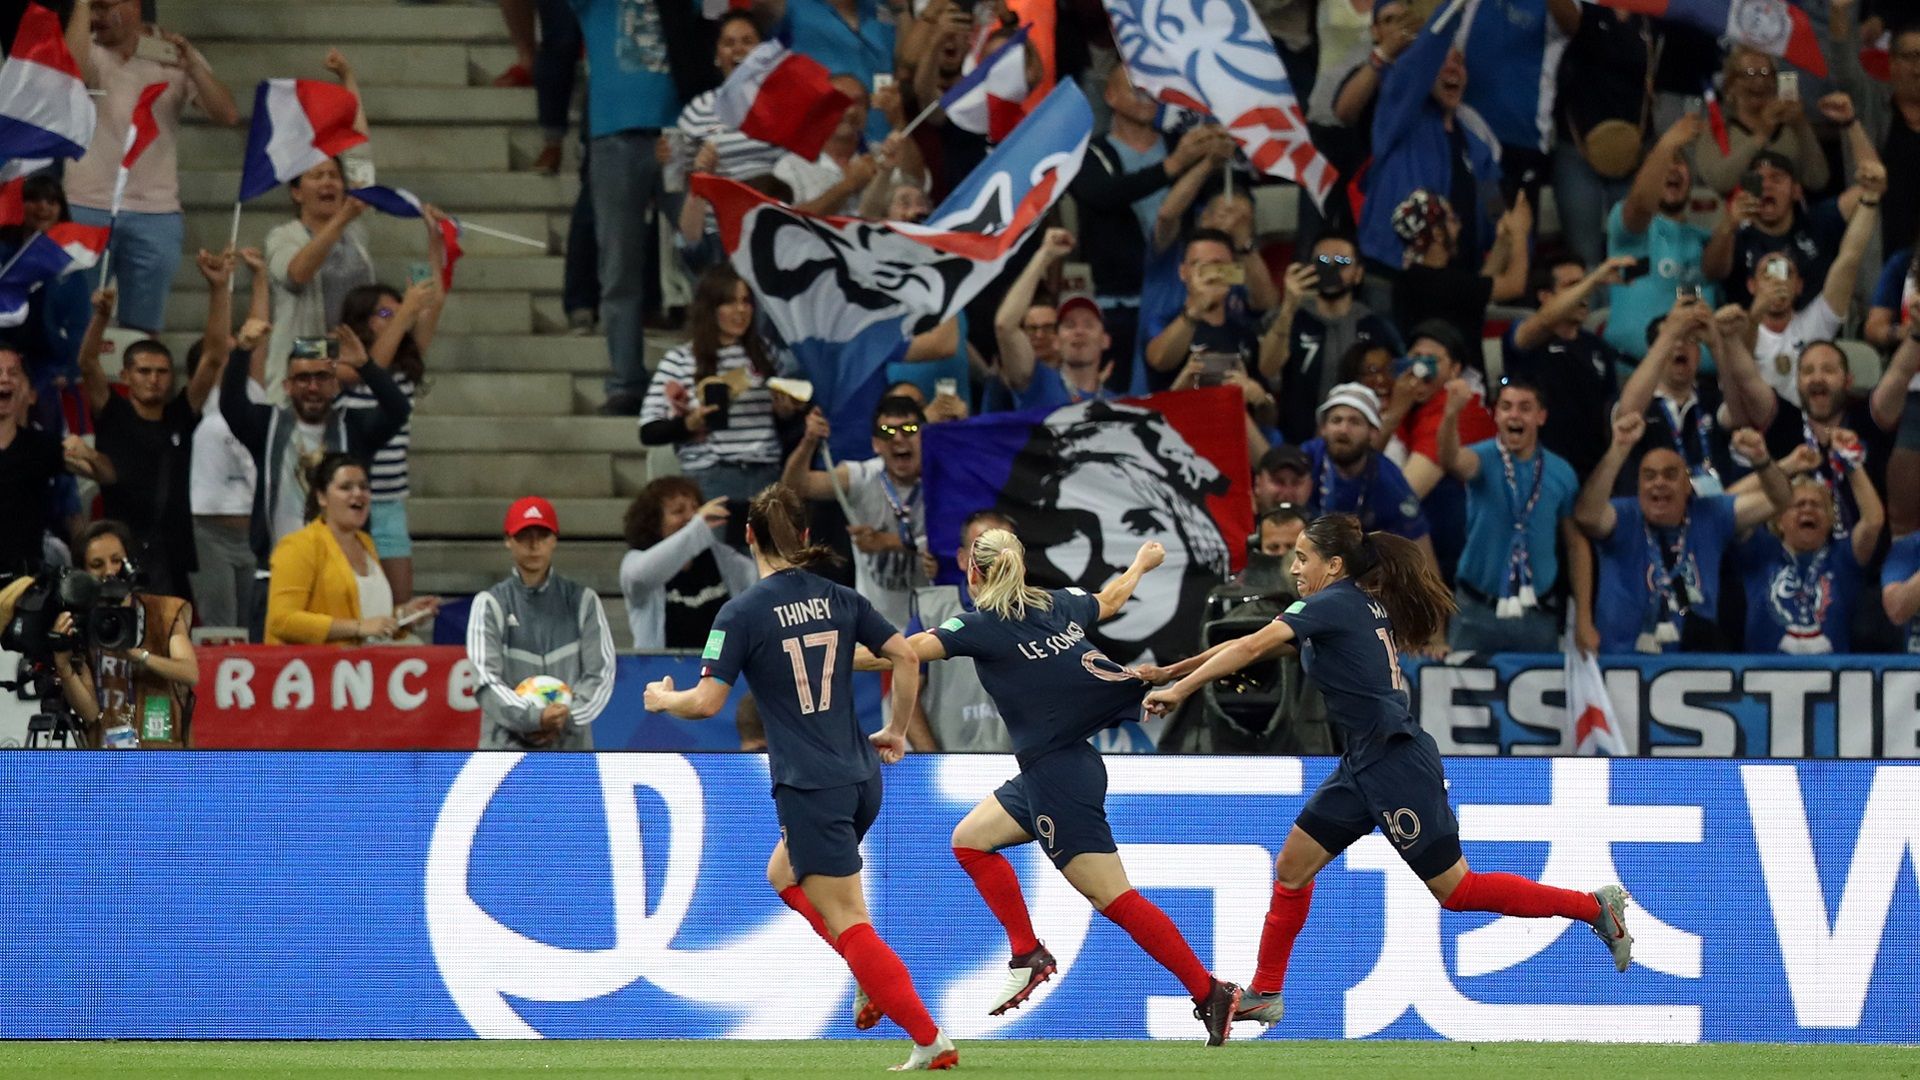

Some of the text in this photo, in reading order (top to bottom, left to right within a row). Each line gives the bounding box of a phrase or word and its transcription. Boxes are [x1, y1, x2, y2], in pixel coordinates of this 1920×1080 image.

[1300, 342, 1319, 374] 7
[773, 598, 832, 628] THINEY
[1017, 641, 1049, 660] LE
[782, 629, 840, 716] 17
[1036, 814, 1055, 849] 9
[1382, 807, 1421, 843] 10
